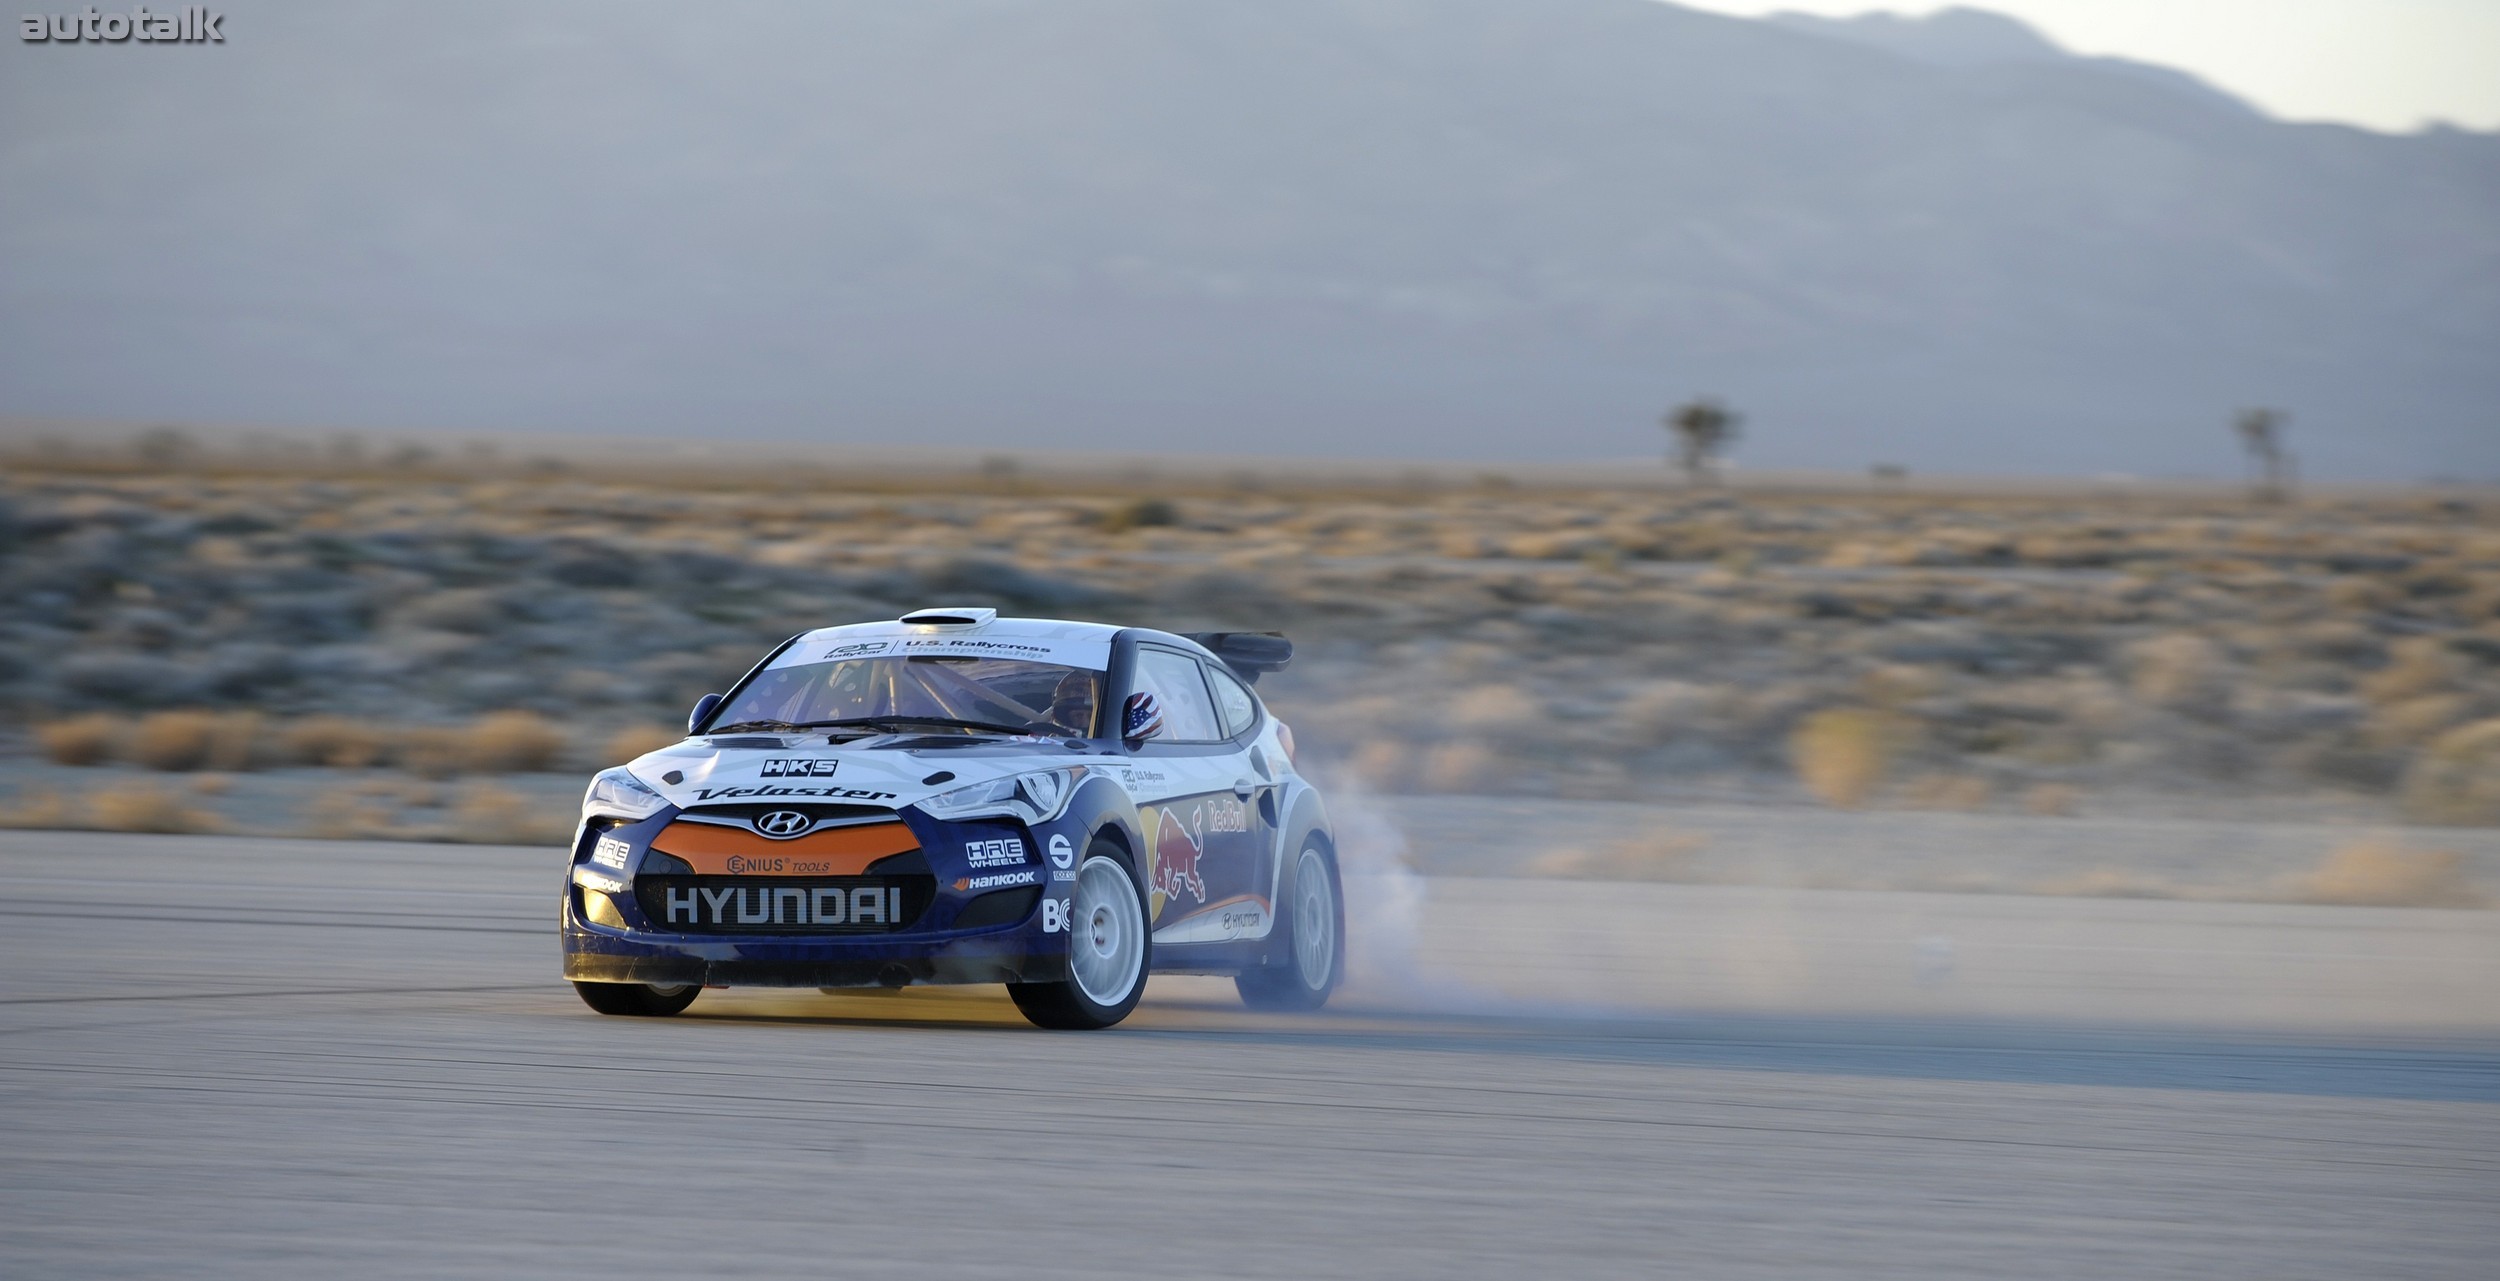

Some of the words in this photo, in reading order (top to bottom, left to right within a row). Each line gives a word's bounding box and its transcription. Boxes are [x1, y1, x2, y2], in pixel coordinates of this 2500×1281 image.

[949, 640, 1051, 653] Rallycross
[761, 759, 838, 777] HKS
[692, 785, 897, 801] Veloster
[966, 839, 1024, 861] HRE
[791, 862, 831, 873] TOOLS
[969, 857, 1026, 869] WHEELS
[666, 886, 901, 924] HYUNDAI
